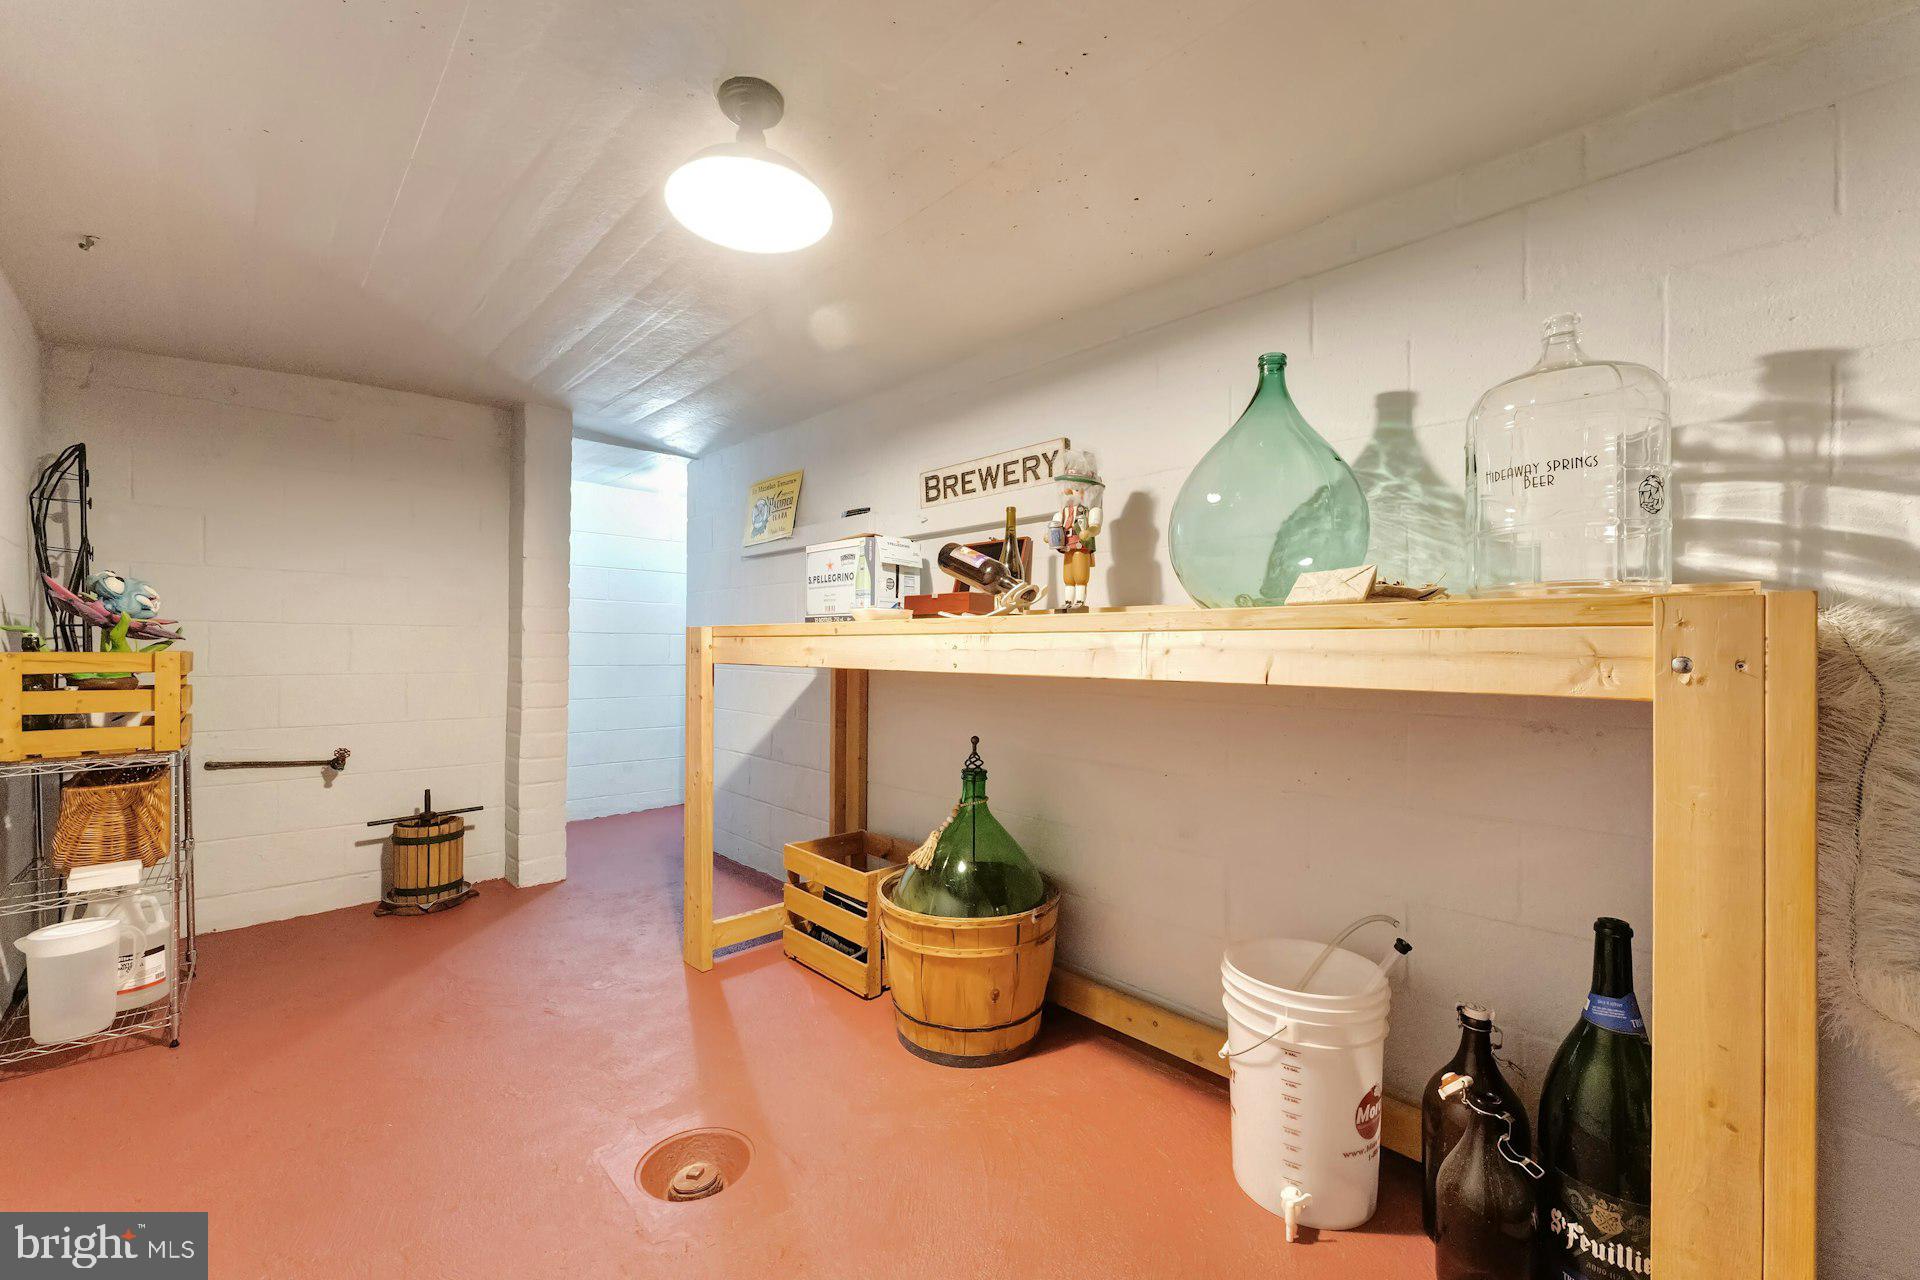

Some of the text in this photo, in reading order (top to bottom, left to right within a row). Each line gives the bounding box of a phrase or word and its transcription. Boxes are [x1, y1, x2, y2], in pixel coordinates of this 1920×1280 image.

[924, 449, 1059, 503] BREWERY
[1485, 455, 1599, 485] HIDEAWAY SPRINGS
[1523, 474, 1555, 490] BEER
[808, 572, 855, 586] S.PELLEGRINO
